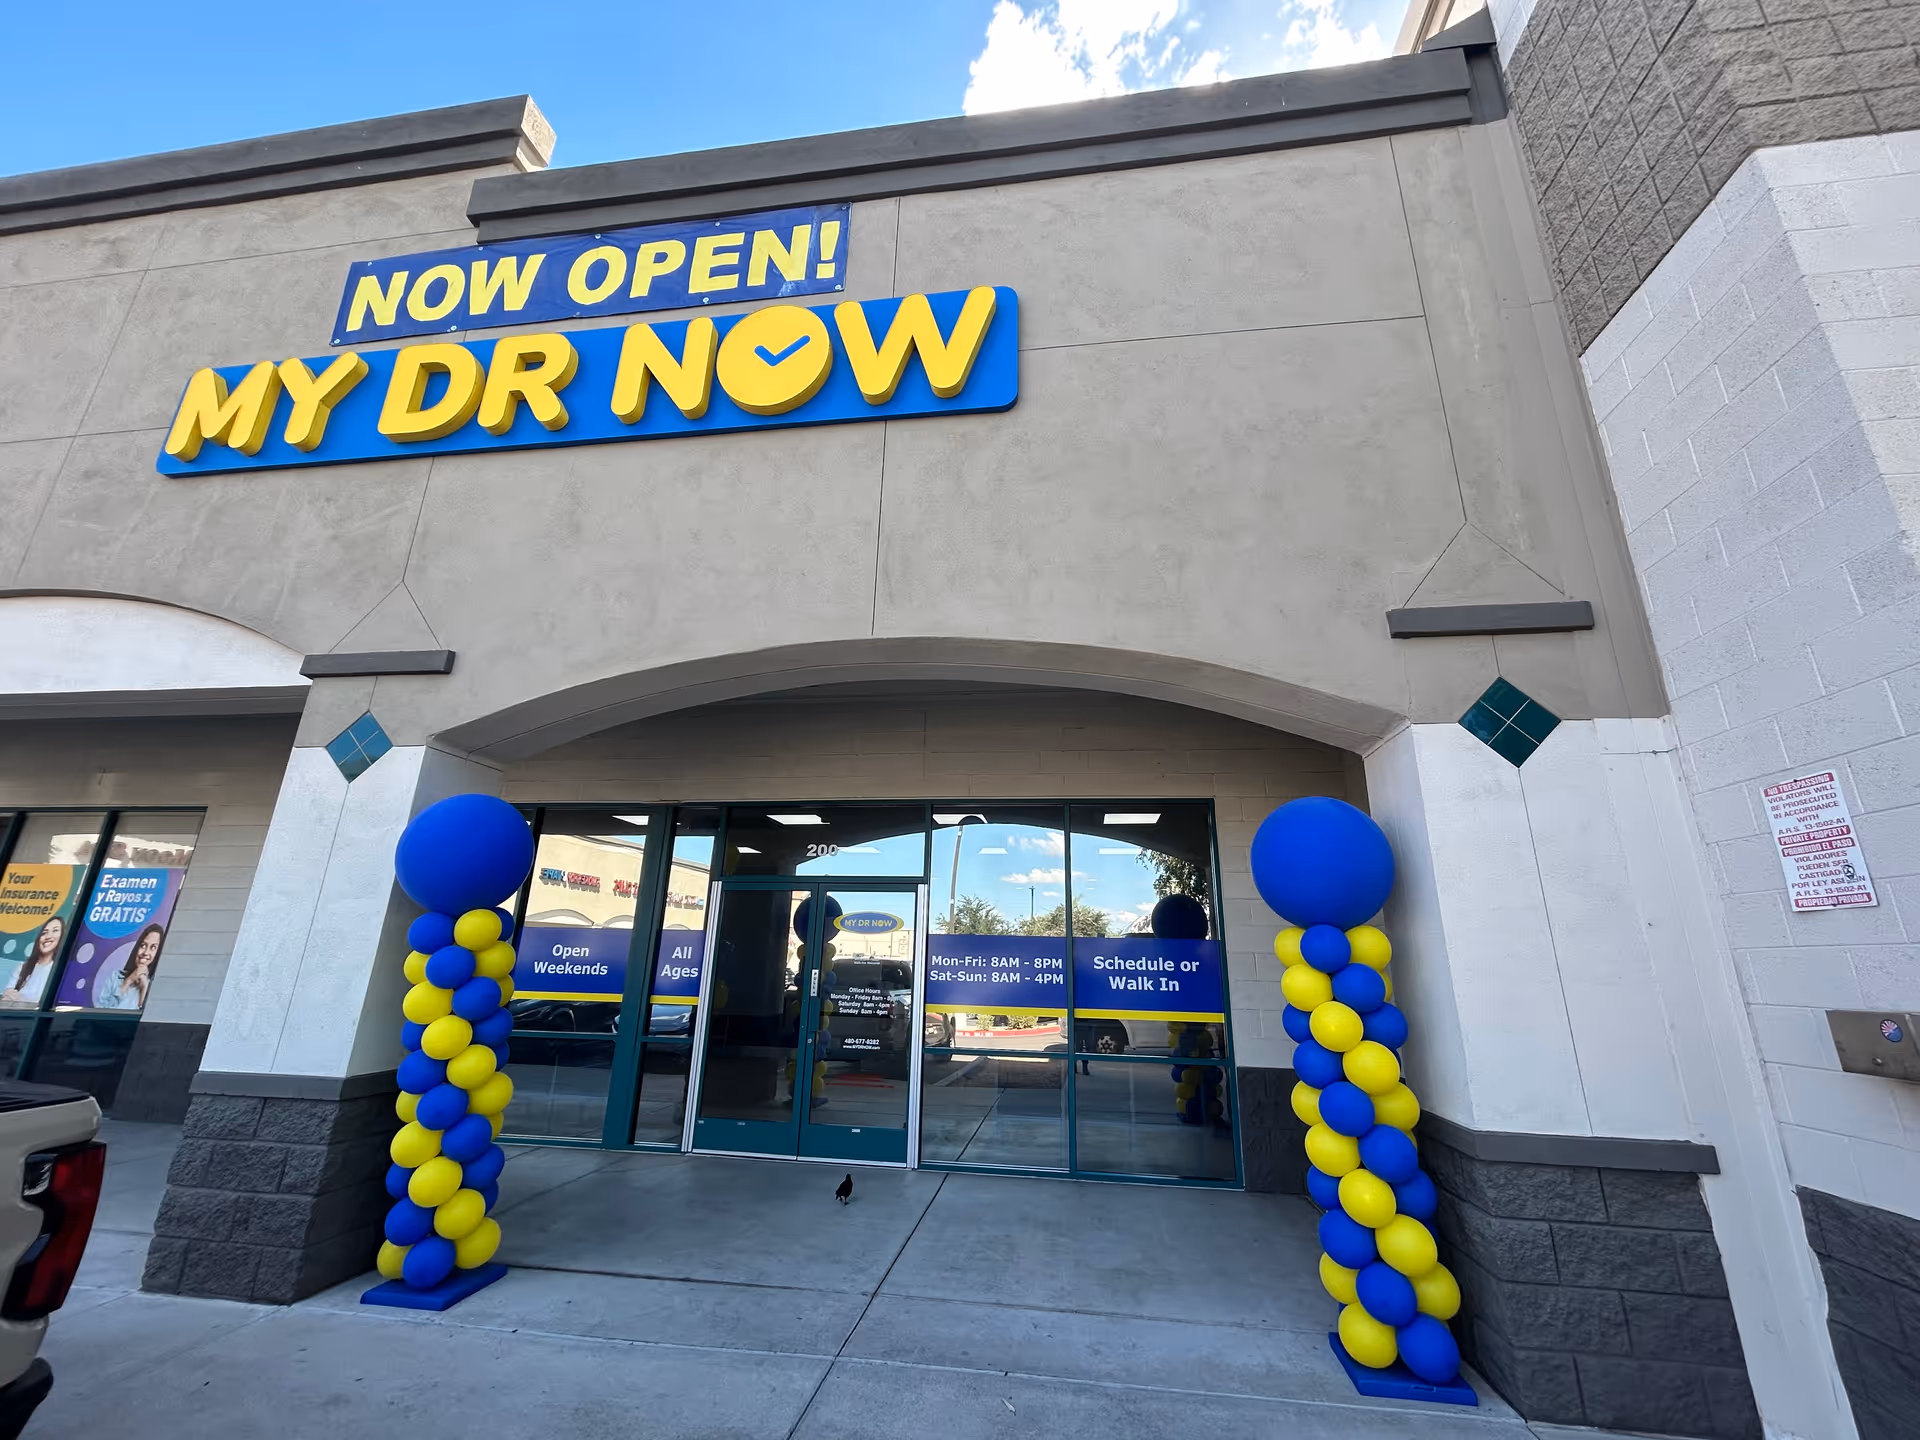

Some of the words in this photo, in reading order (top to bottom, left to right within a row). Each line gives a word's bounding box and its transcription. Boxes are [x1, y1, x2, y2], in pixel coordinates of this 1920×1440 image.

[344, 253, 547, 333] NOW
[567, 220, 843, 306] OPEN!
[165, 352, 369, 463] MY
[378, 333, 573, 443] DR
[610, 286, 996, 425] NOW
[1767, 788, 1778, 796] NO
[1778, 774, 1830, 792] TRESPASSING
[1768, 789, 1811, 804] VIOLATORS
[1813, 784, 1836, 793] WILL
[1783, 792, 1837, 809] PROSECUTED
[1784, 800, 1839, 817] ACCORDANCE
[1796, 814, 1819, 823] WITH
[1804, 817, 1846, 830] 13-1502-A1
[1780, 833, 1810, 845] PRIVATE
[1809, 826, 1848, 841] PROPERTY
[806, 844, 839, 857] 200
[1783, 844, 1821, 856] PROHIBIDO
[1832, 838, 1853, 848] PASO
[1794, 850, 1847, 863] VIOLADORES
[1797, 861, 1830, 871] PUEDEN
[8, 872, 34, 884] Your
[1799, 868, 1845, 879] CASTIGAD
[101, 874, 158, 889] Examen
[1792, 881, 1810, 889] POR
[1812, 879, 1828, 887] LEY
[0, 887, 59, 900] Insurance
[1824, 884, 1866, 895] 13-1502-A1
[95, 892, 105, 905] y
[105, 889, 142, 905] Rayos
[1797, 897, 1838, 907] PROPIEDAD
[1838, 894, 1869, 904] PRIVADA
[844, 919, 857, 927] MY
[858, 919, 870, 927] DR
[871, 919, 893, 928] NOW
[552, 944, 590, 959] Open
[672, 946, 692, 960] All
[533, 961, 608, 976] Weekends
[931, 955, 986, 967] Mon-Fri:
[990, 957, 1020, 968] 8AM
[1033, 958, 1063, 969] 8PM
[1093, 956, 1175, 971] Schedule
[1180, 961, 1200, 972] or
[661, 964, 699, 979] Ages
[929, 970, 987, 982] Sat-Sun:
[991, 972, 1020, 983] 8AM
[1034, 973, 1064, 985] 4PM
[1108, 976, 1154, 991] Walk
[1159, 977, 1180, 992] In
[830, 993, 851, 1001] Monday
[855, 994, 871, 1002] Friday
[839, 1007, 859, 1015] Sunday
